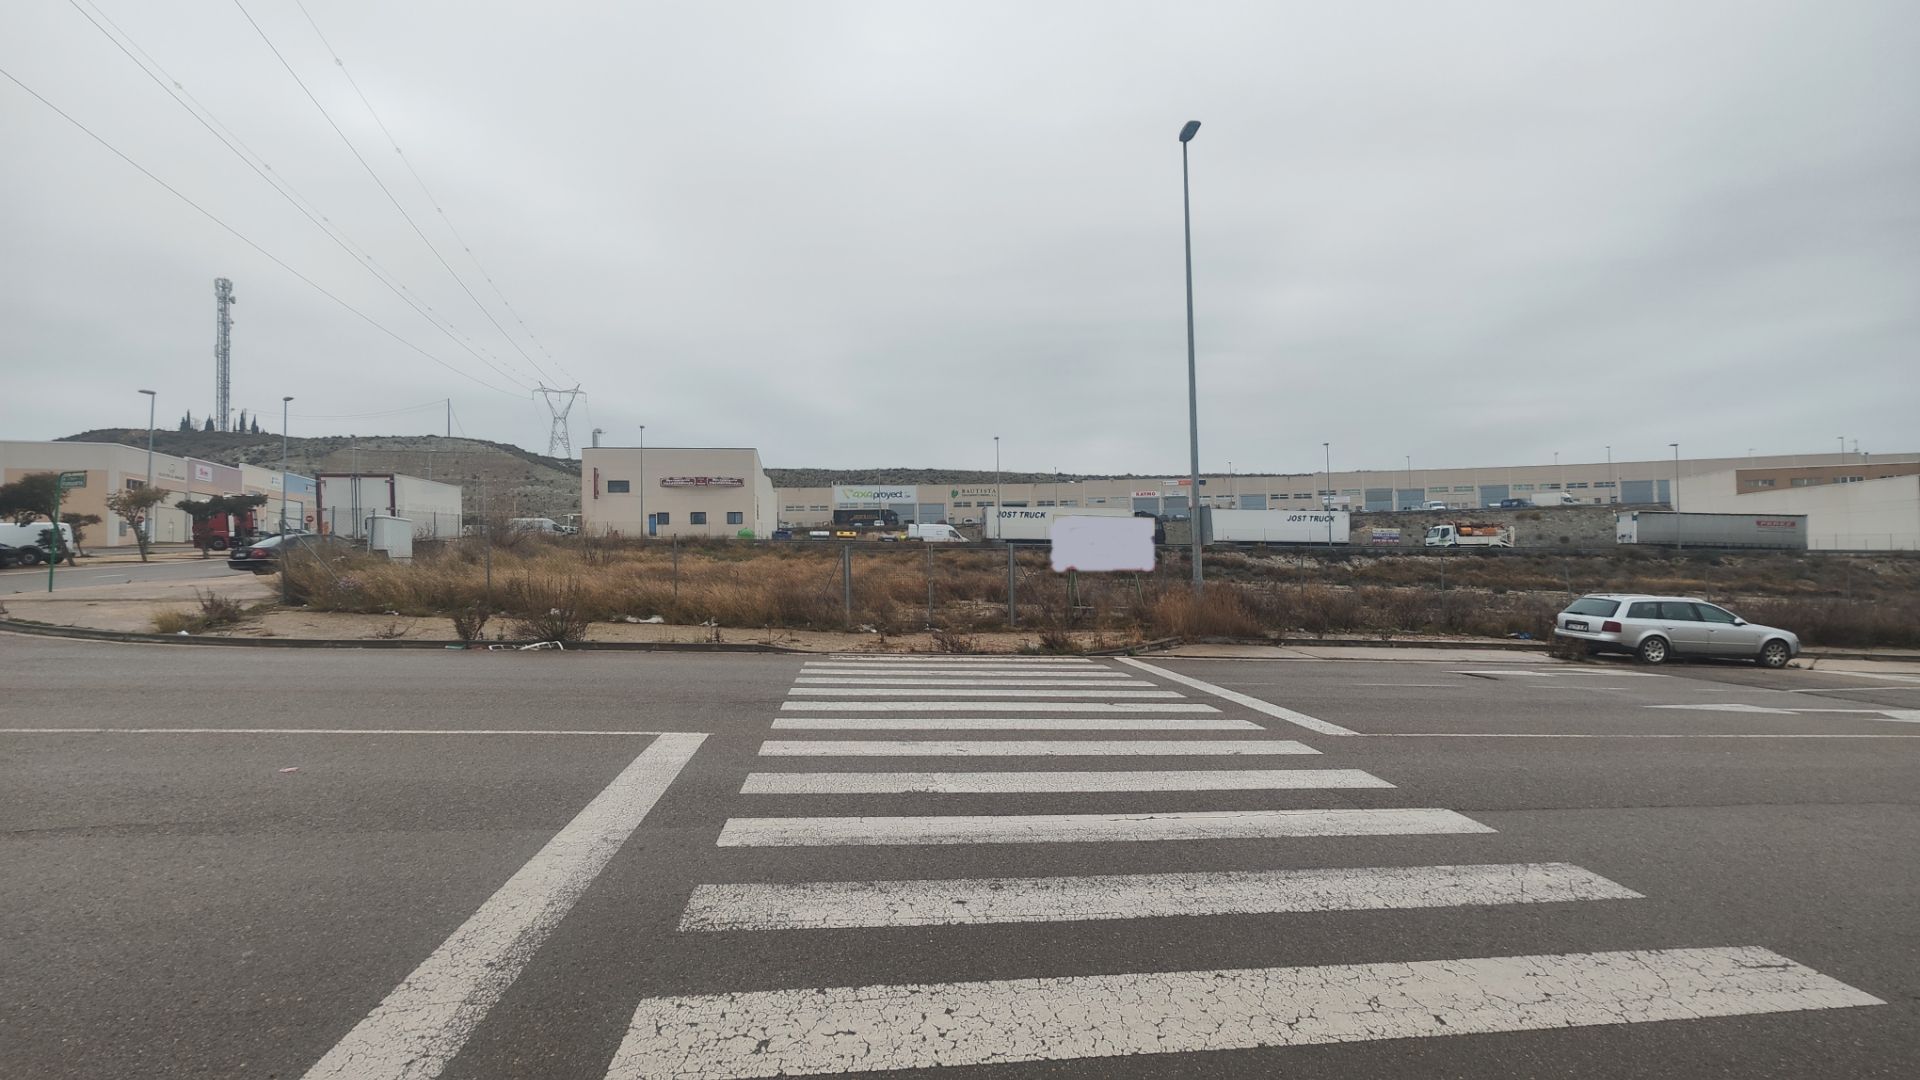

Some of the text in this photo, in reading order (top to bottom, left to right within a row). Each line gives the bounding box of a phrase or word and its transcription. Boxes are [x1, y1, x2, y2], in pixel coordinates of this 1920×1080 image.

[996, 511, 1047, 519] JOST TRUCK
[1309, 515, 1336, 523] TRUCK
